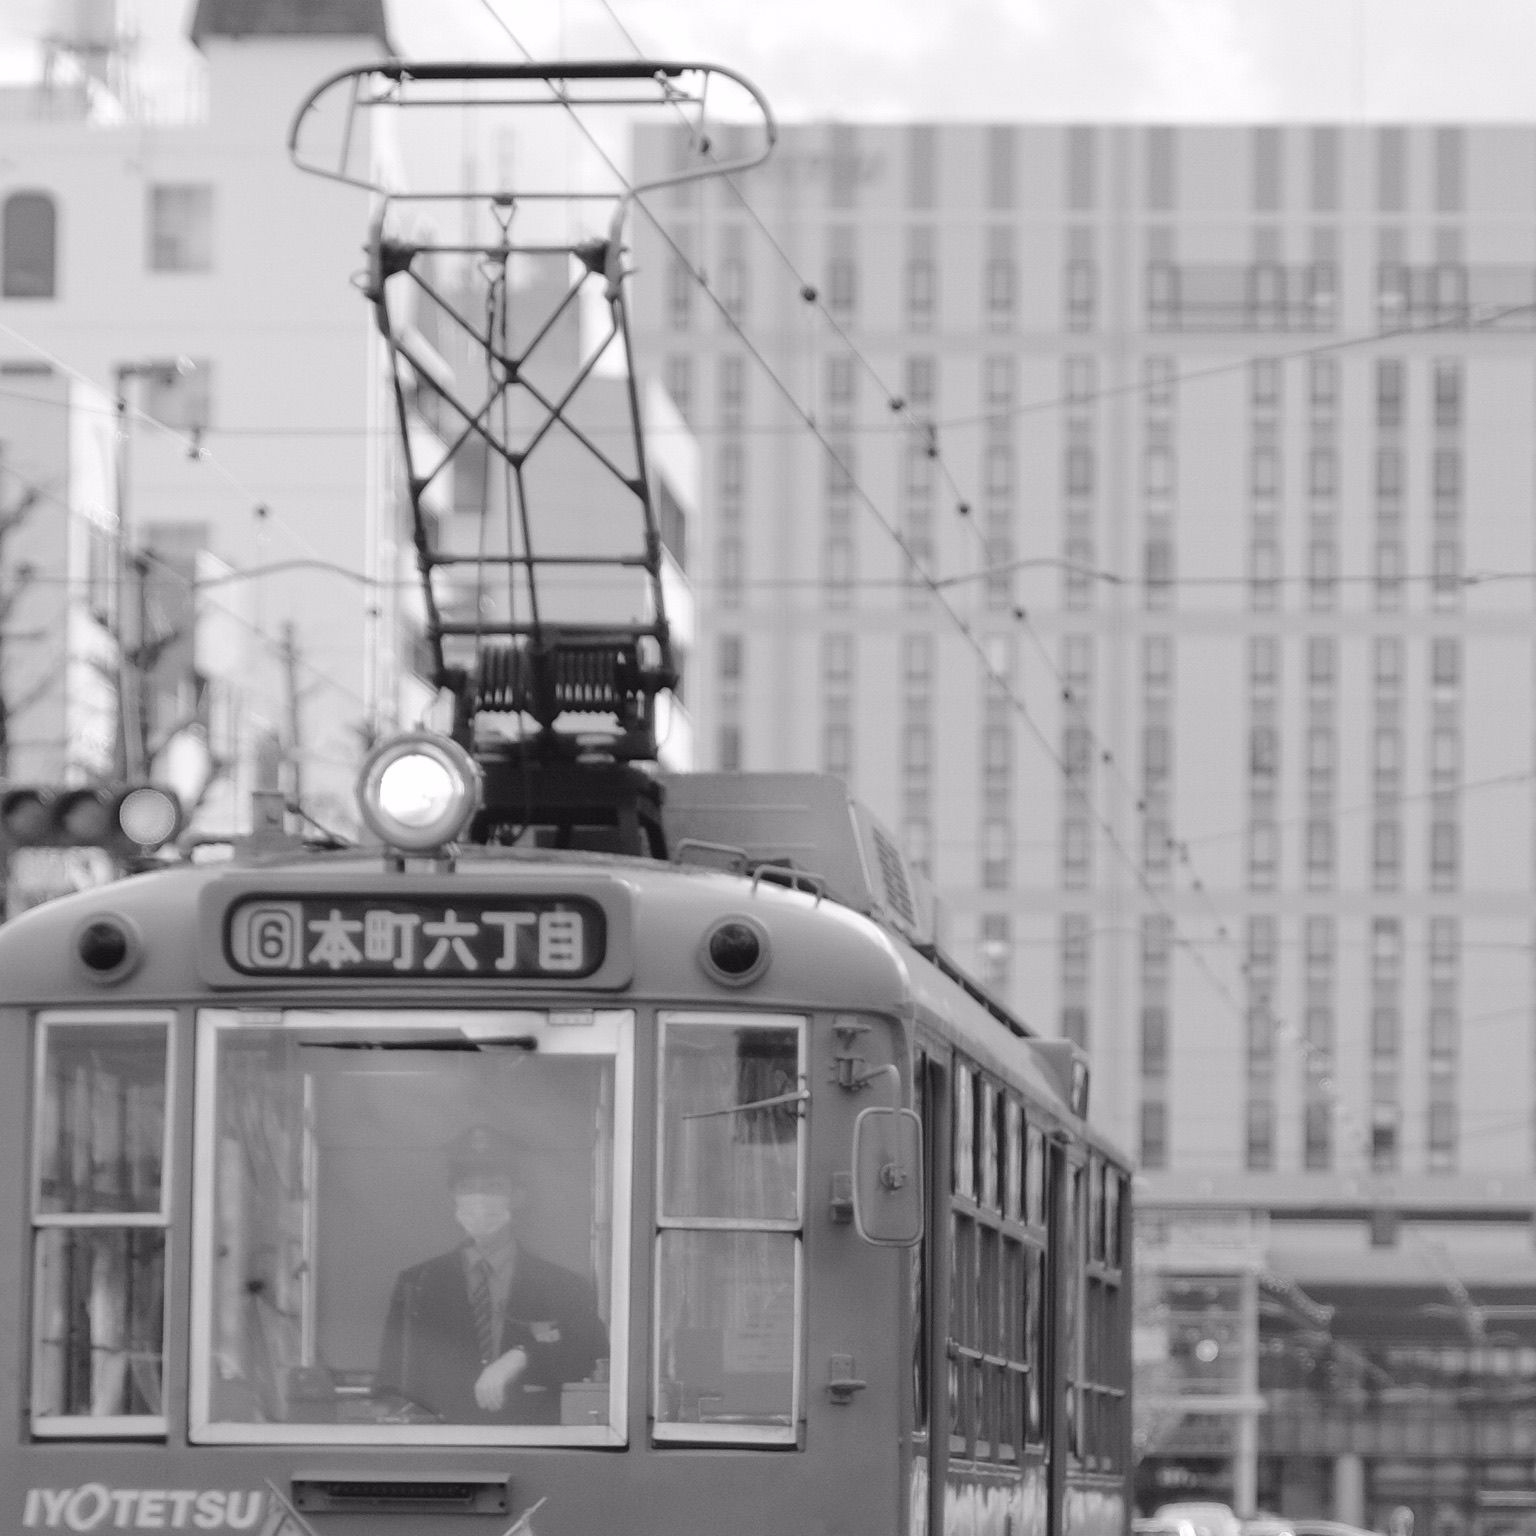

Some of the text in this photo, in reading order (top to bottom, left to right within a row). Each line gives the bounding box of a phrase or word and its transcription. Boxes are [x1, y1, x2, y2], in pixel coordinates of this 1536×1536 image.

[307, 907, 584, 972] 本町六丁目
[21, 1481, 263, 1533] IYOTETSU
